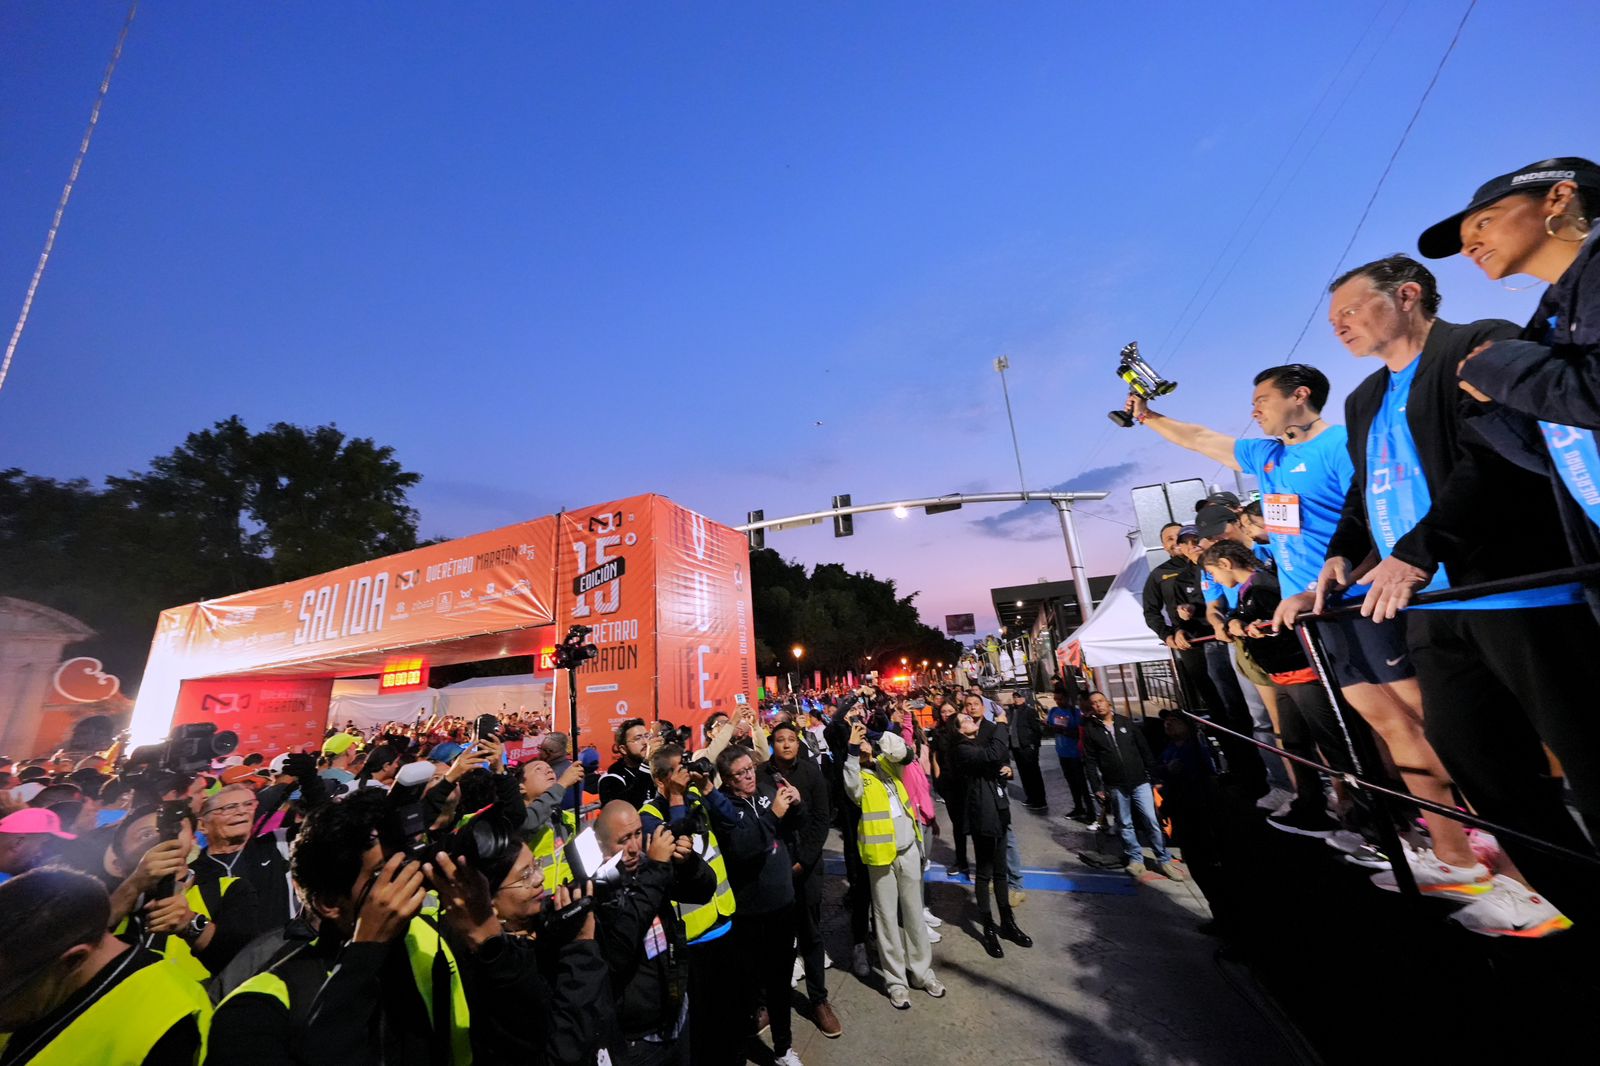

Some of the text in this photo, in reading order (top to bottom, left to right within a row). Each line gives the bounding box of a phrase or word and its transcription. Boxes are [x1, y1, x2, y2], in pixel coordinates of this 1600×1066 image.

[425, 557, 474, 583] QUERÉTARO
[475, 545, 519, 571] MARATÓN
[579, 561, 618, 594] EDICIÓN
[293, 571, 389, 646] SALIDA
